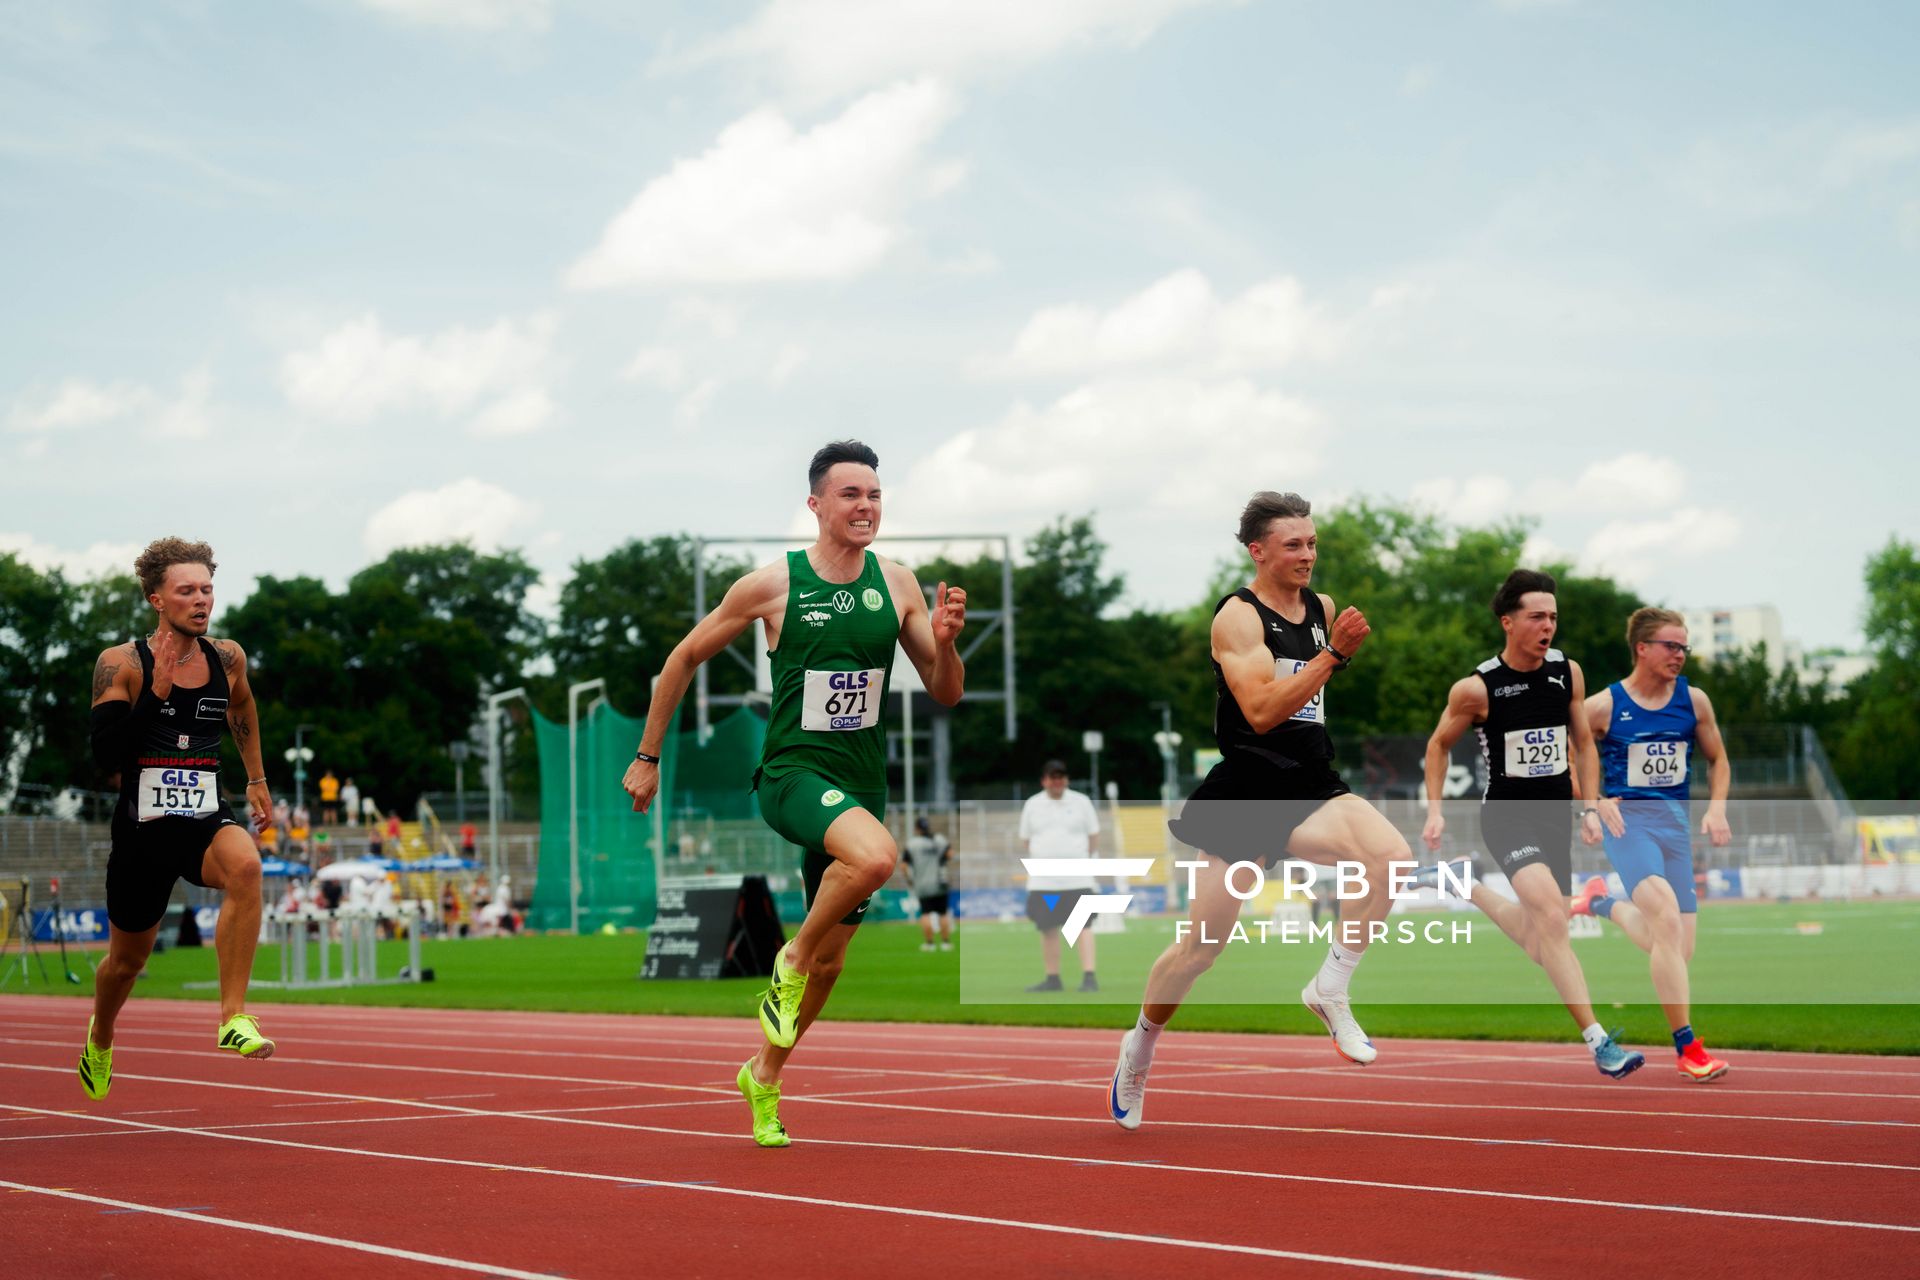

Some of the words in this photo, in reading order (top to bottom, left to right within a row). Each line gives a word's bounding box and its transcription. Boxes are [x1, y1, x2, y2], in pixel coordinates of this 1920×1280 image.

[825, 691, 867, 715] 671
[844, 717, 861, 725] PLAN
[1516, 743, 1561, 765] 1291
[1642, 757, 1679, 775] 604
[152, 787, 205, 809] 1517
